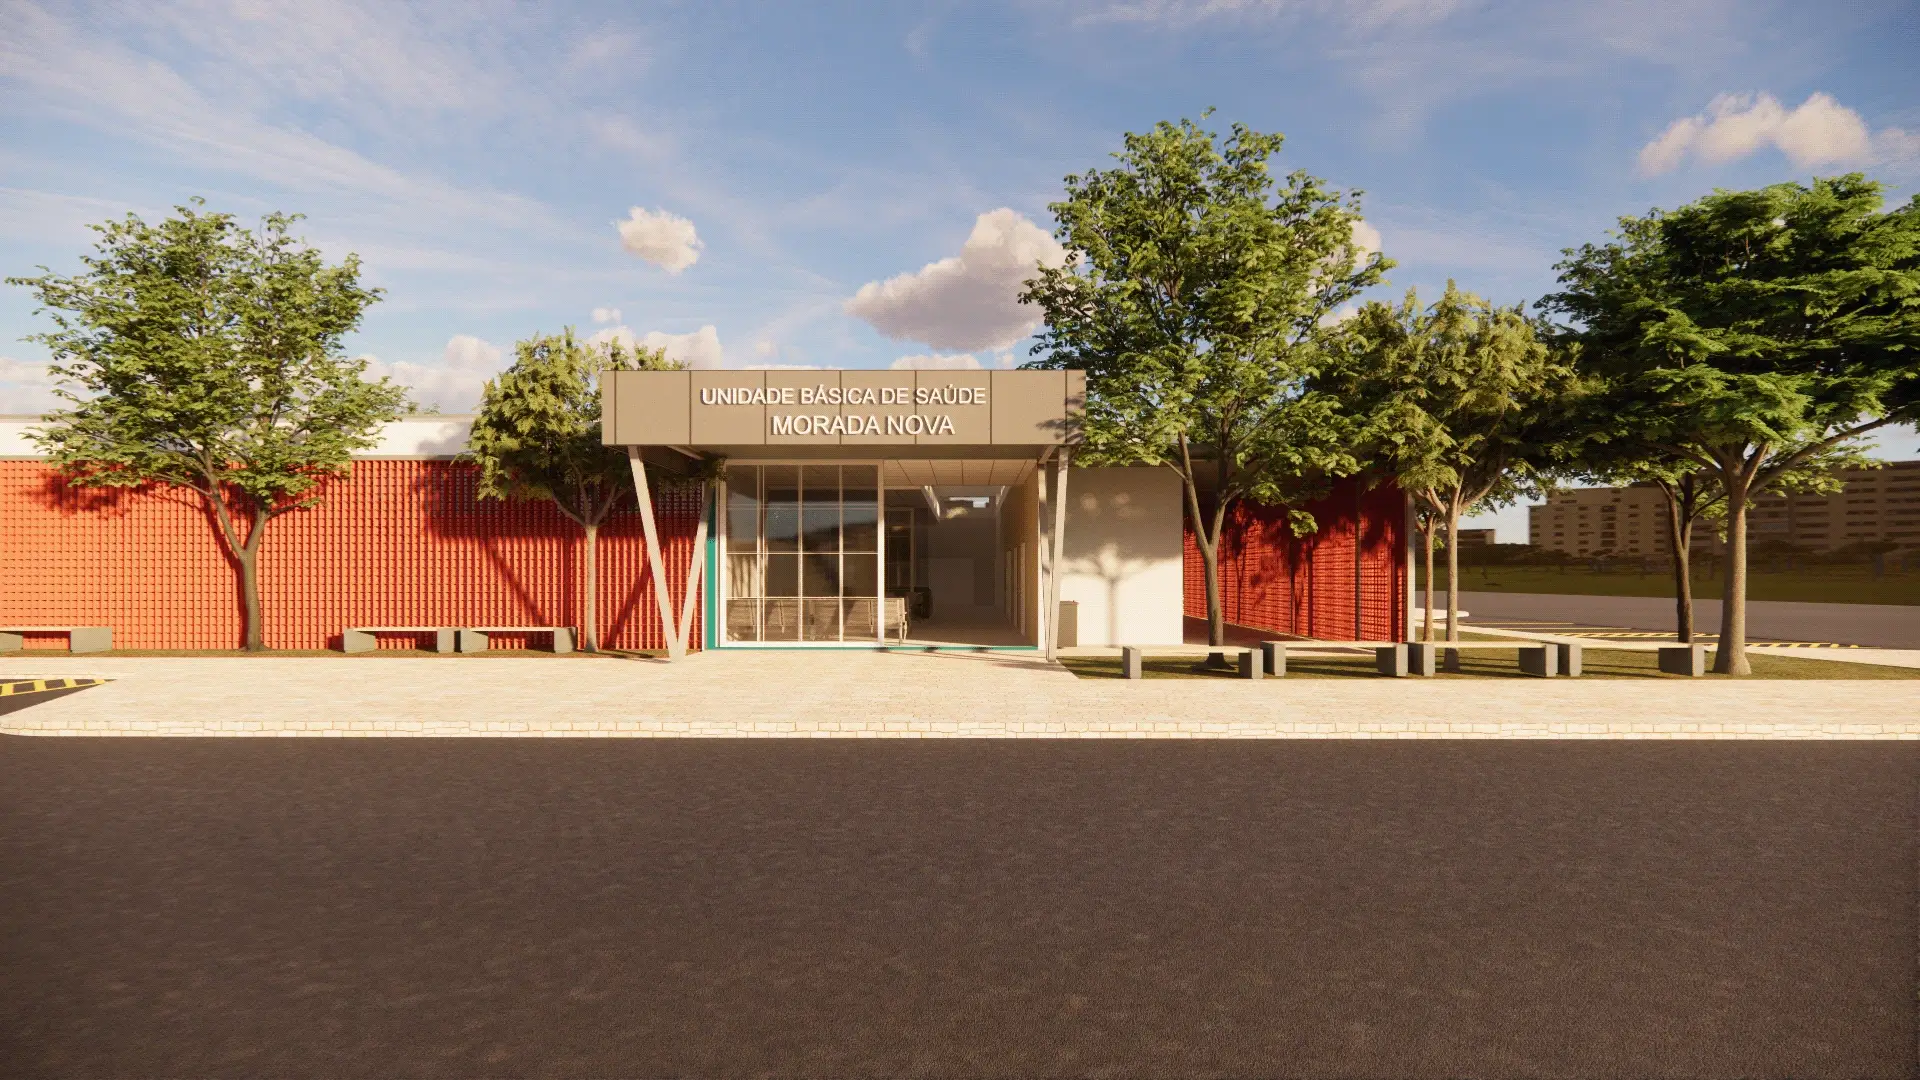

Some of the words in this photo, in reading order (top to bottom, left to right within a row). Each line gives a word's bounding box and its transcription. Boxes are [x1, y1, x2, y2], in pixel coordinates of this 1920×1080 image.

[701, 387, 795, 405] UNIDADE
[800, 384, 876, 405] BÁSICA
[881, 387, 910, 405] DE
[915, 384, 987, 405] SAÚDE
[772, 415, 880, 435] MORADA
[887, 415, 956, 435] NOVA
